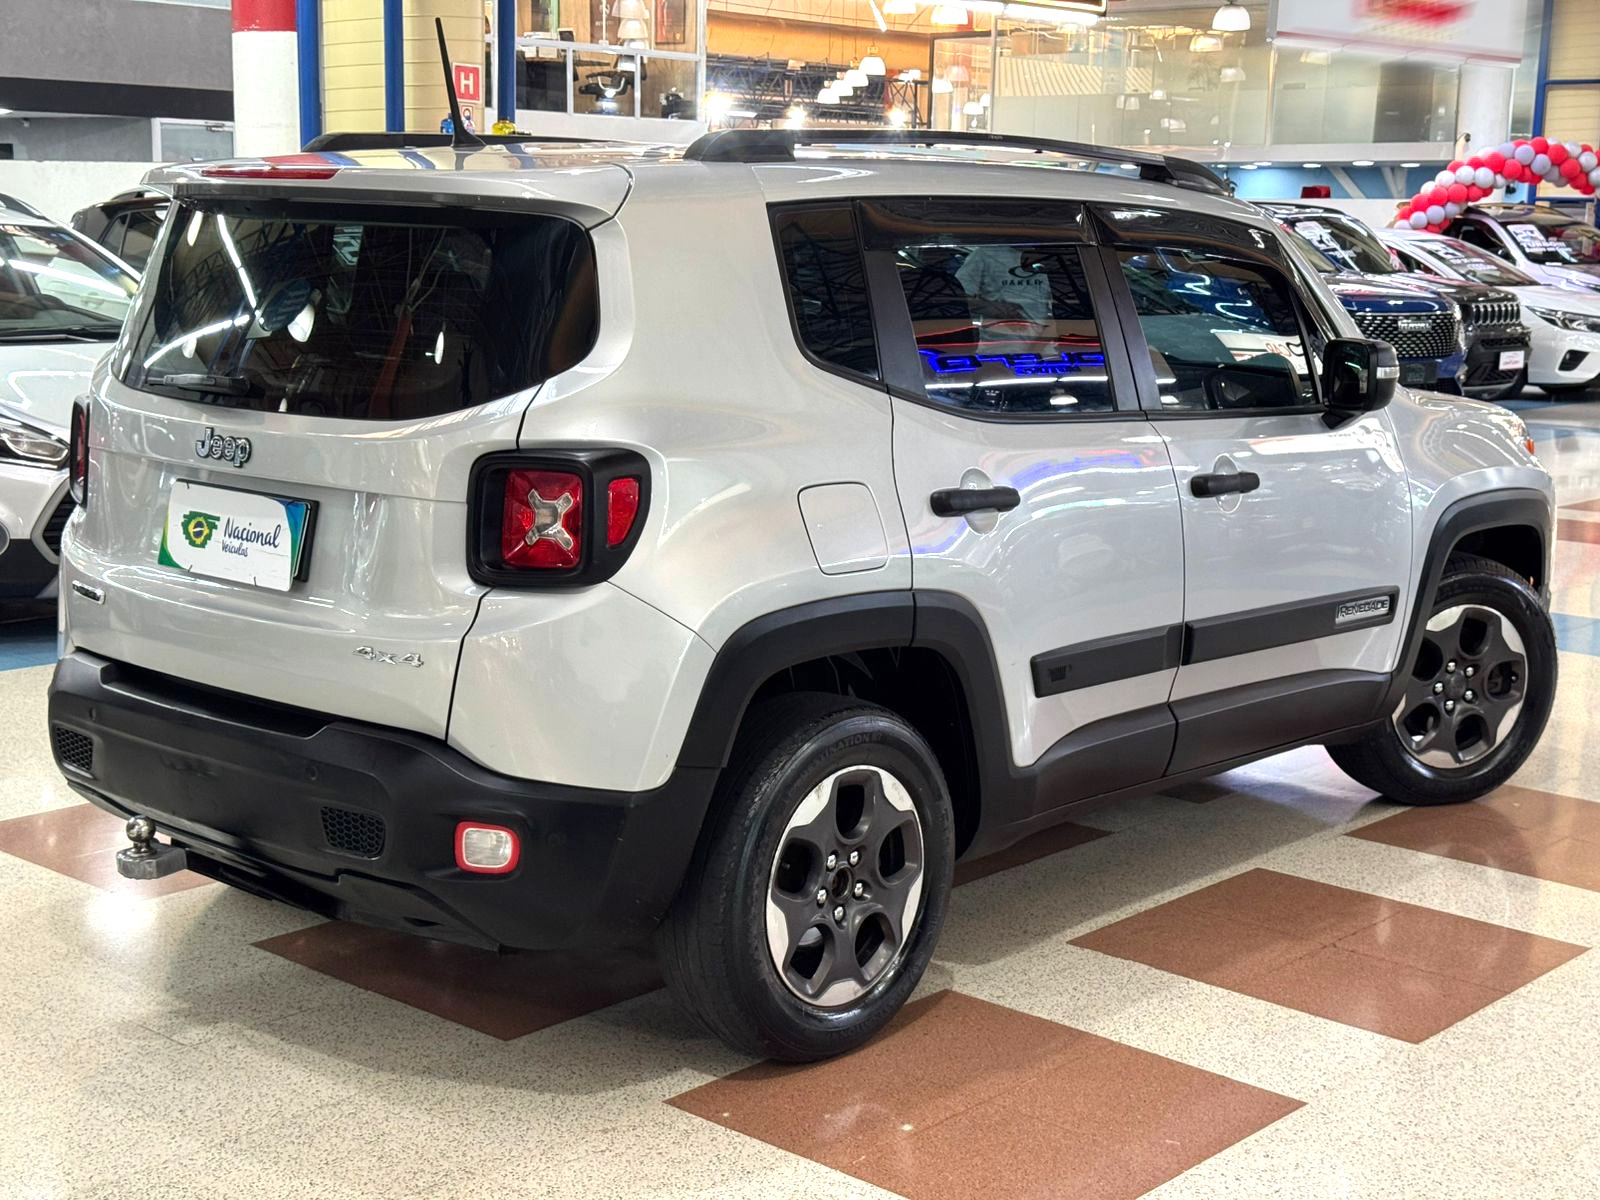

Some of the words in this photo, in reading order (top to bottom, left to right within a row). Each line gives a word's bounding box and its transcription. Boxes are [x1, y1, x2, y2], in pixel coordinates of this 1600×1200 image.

[460, 71, 474, 94] H
[195, 427, 252, 468] Jeep
[224, 517, 281, 548] Nacional
[1340, 599, 1389, 617] RENEGADE
[352, 645, 425, 668] 4x4
